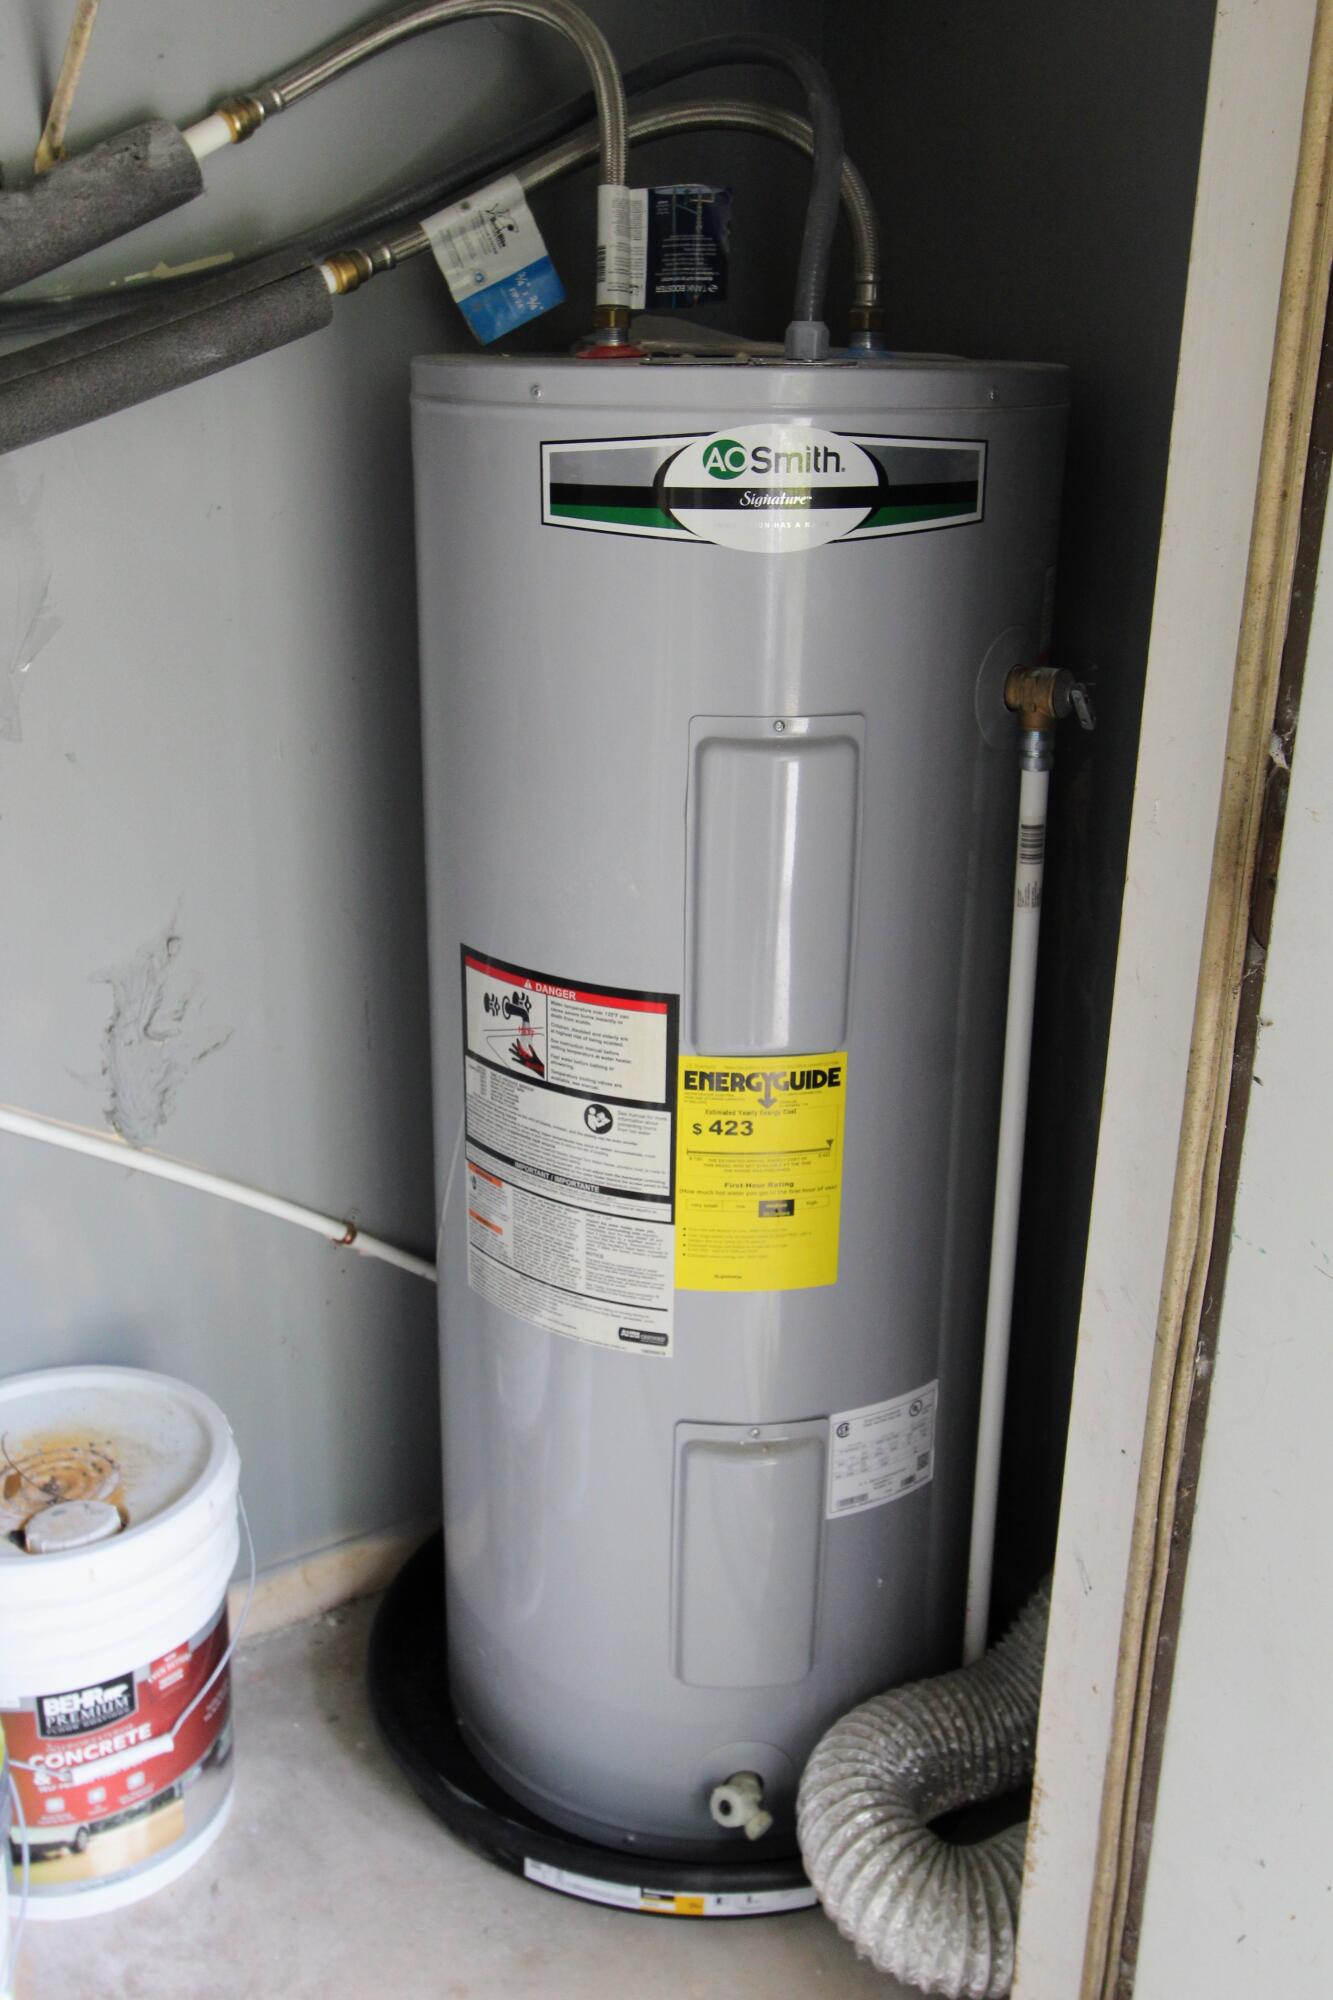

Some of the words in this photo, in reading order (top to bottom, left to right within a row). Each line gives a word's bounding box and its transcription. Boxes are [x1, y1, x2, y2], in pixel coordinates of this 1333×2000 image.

[535, 982, 576, 1001] DANGER
[692, 1122, 703, 1136] $
[708, 1119, 754, 1136] 423
[514, 1161, 549, 1180] IMPORTANT
[554, 1175, 600, 1194] IMPORTANTE
[43, 1686, 104, 1717] BEHR
[46, 1694, 130, 1729] PREMIUM
[28, 1722, 152, 1771] CONCRETE
